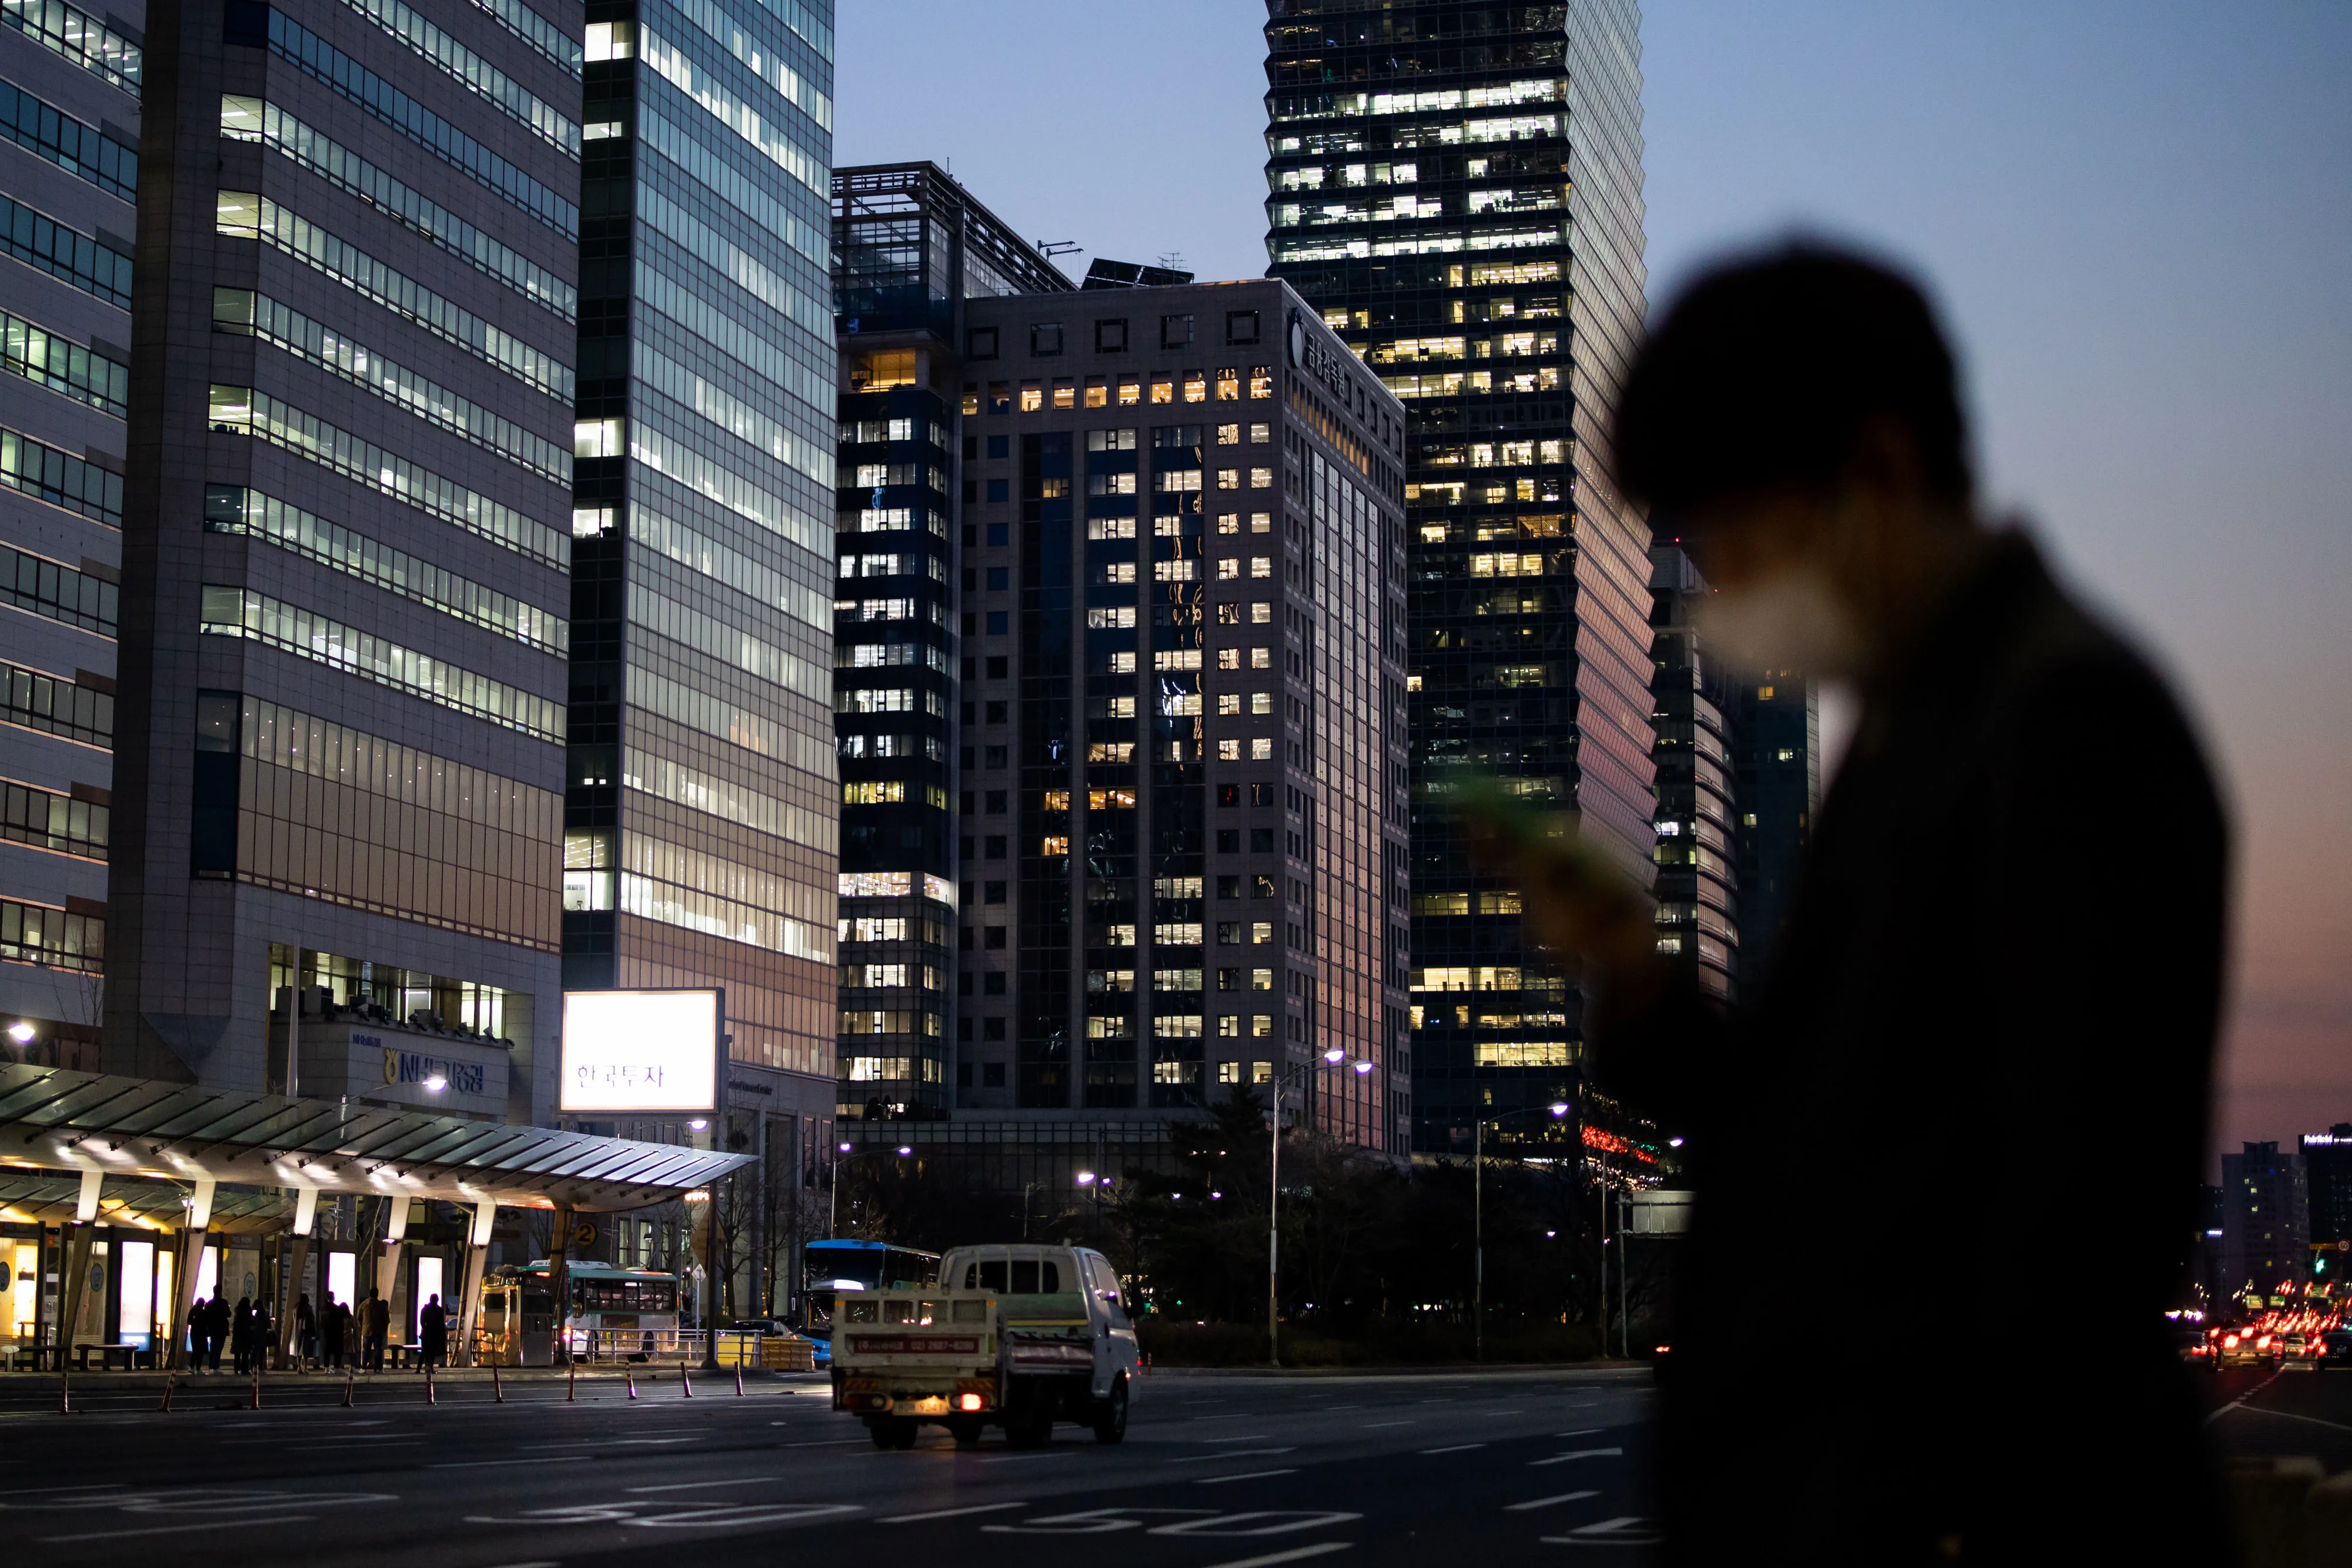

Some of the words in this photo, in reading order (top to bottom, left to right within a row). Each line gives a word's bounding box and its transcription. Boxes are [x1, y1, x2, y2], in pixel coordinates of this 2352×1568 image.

[1308, 333, 1345, 398] 금융감독원
[577, 1065, 664, 1088] 한국투자
[578, 1225, 592, 1242] 2
